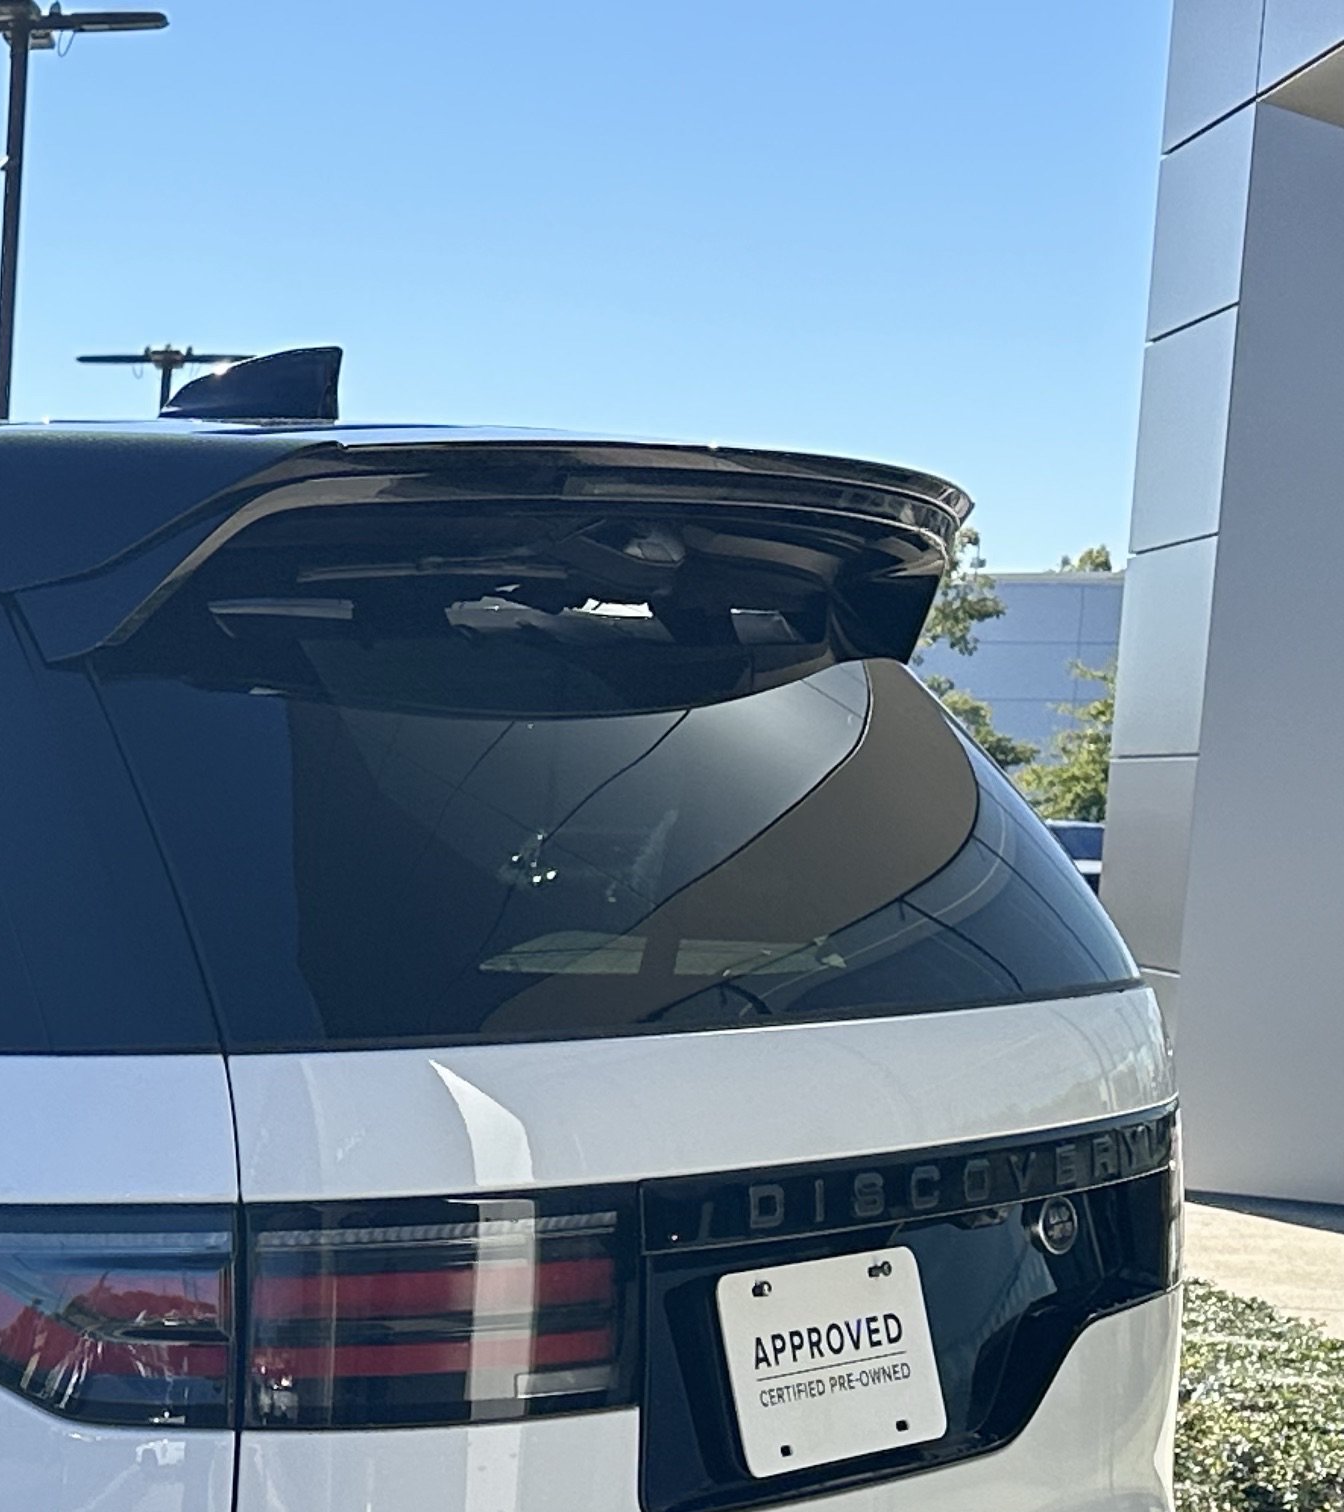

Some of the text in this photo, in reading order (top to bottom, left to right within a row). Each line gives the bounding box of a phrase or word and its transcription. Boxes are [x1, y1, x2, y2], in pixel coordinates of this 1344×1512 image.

[749, 1122, 1150, 1229] DISCOVERY
[754, 1313, 903, 1370] APPROVED
[759, 1362, 912, 1408] CERTIFIED PRE-OWNED
